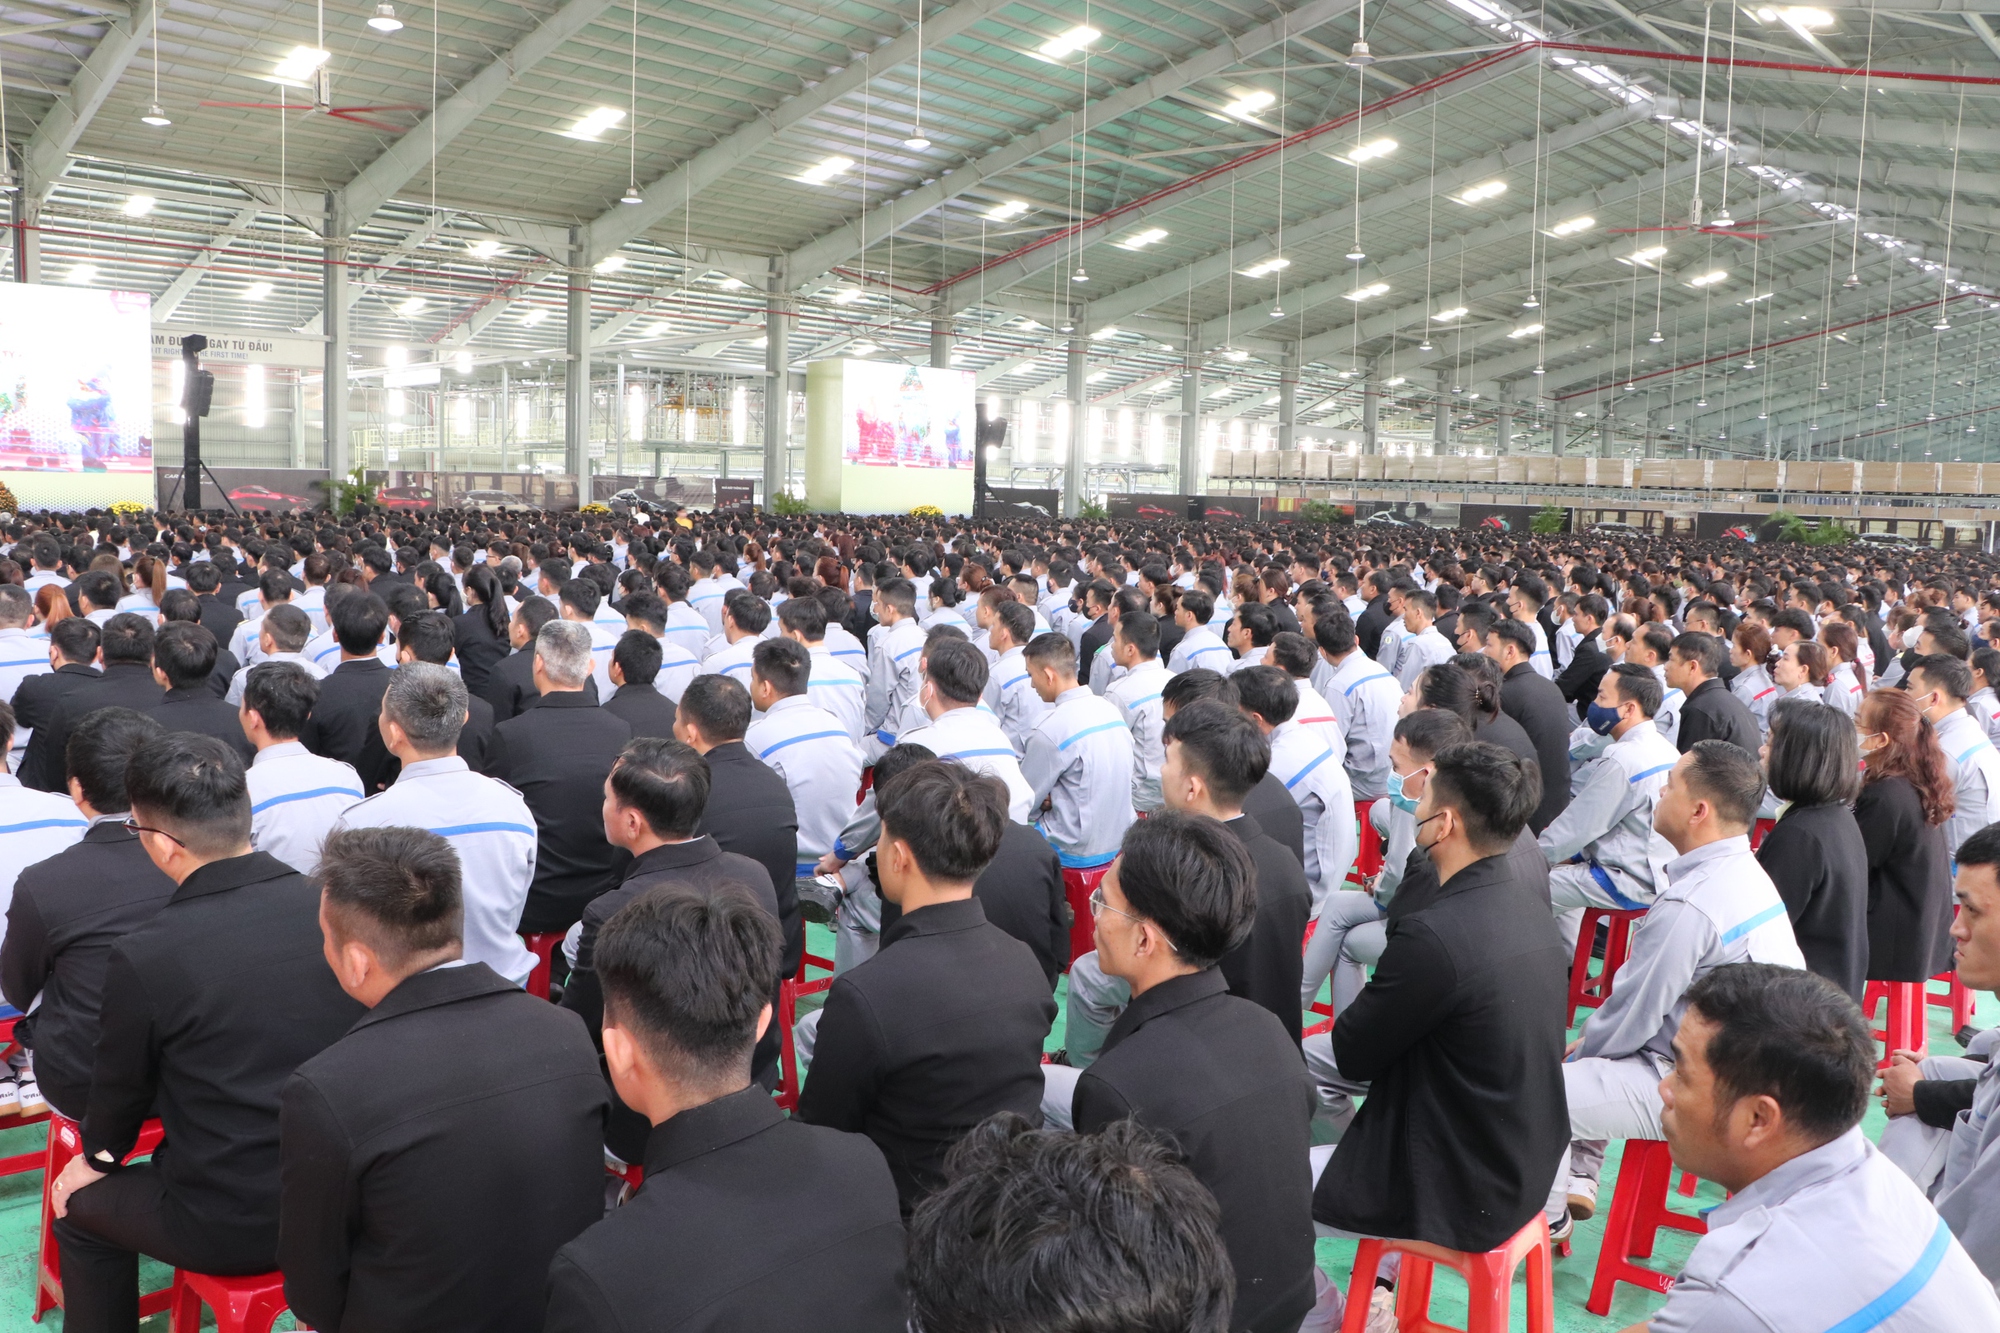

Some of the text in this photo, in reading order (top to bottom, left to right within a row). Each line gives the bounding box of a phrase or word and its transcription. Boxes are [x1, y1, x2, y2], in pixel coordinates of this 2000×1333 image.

[169, 334, 183, 347] ĐÚ
[232, 338, 246, 351] TỪ
[248, 338, 273, 353] ĐẦU!
[210, 351, 229, 359] FIRST
[231, 352, 249, 360] TIME!
